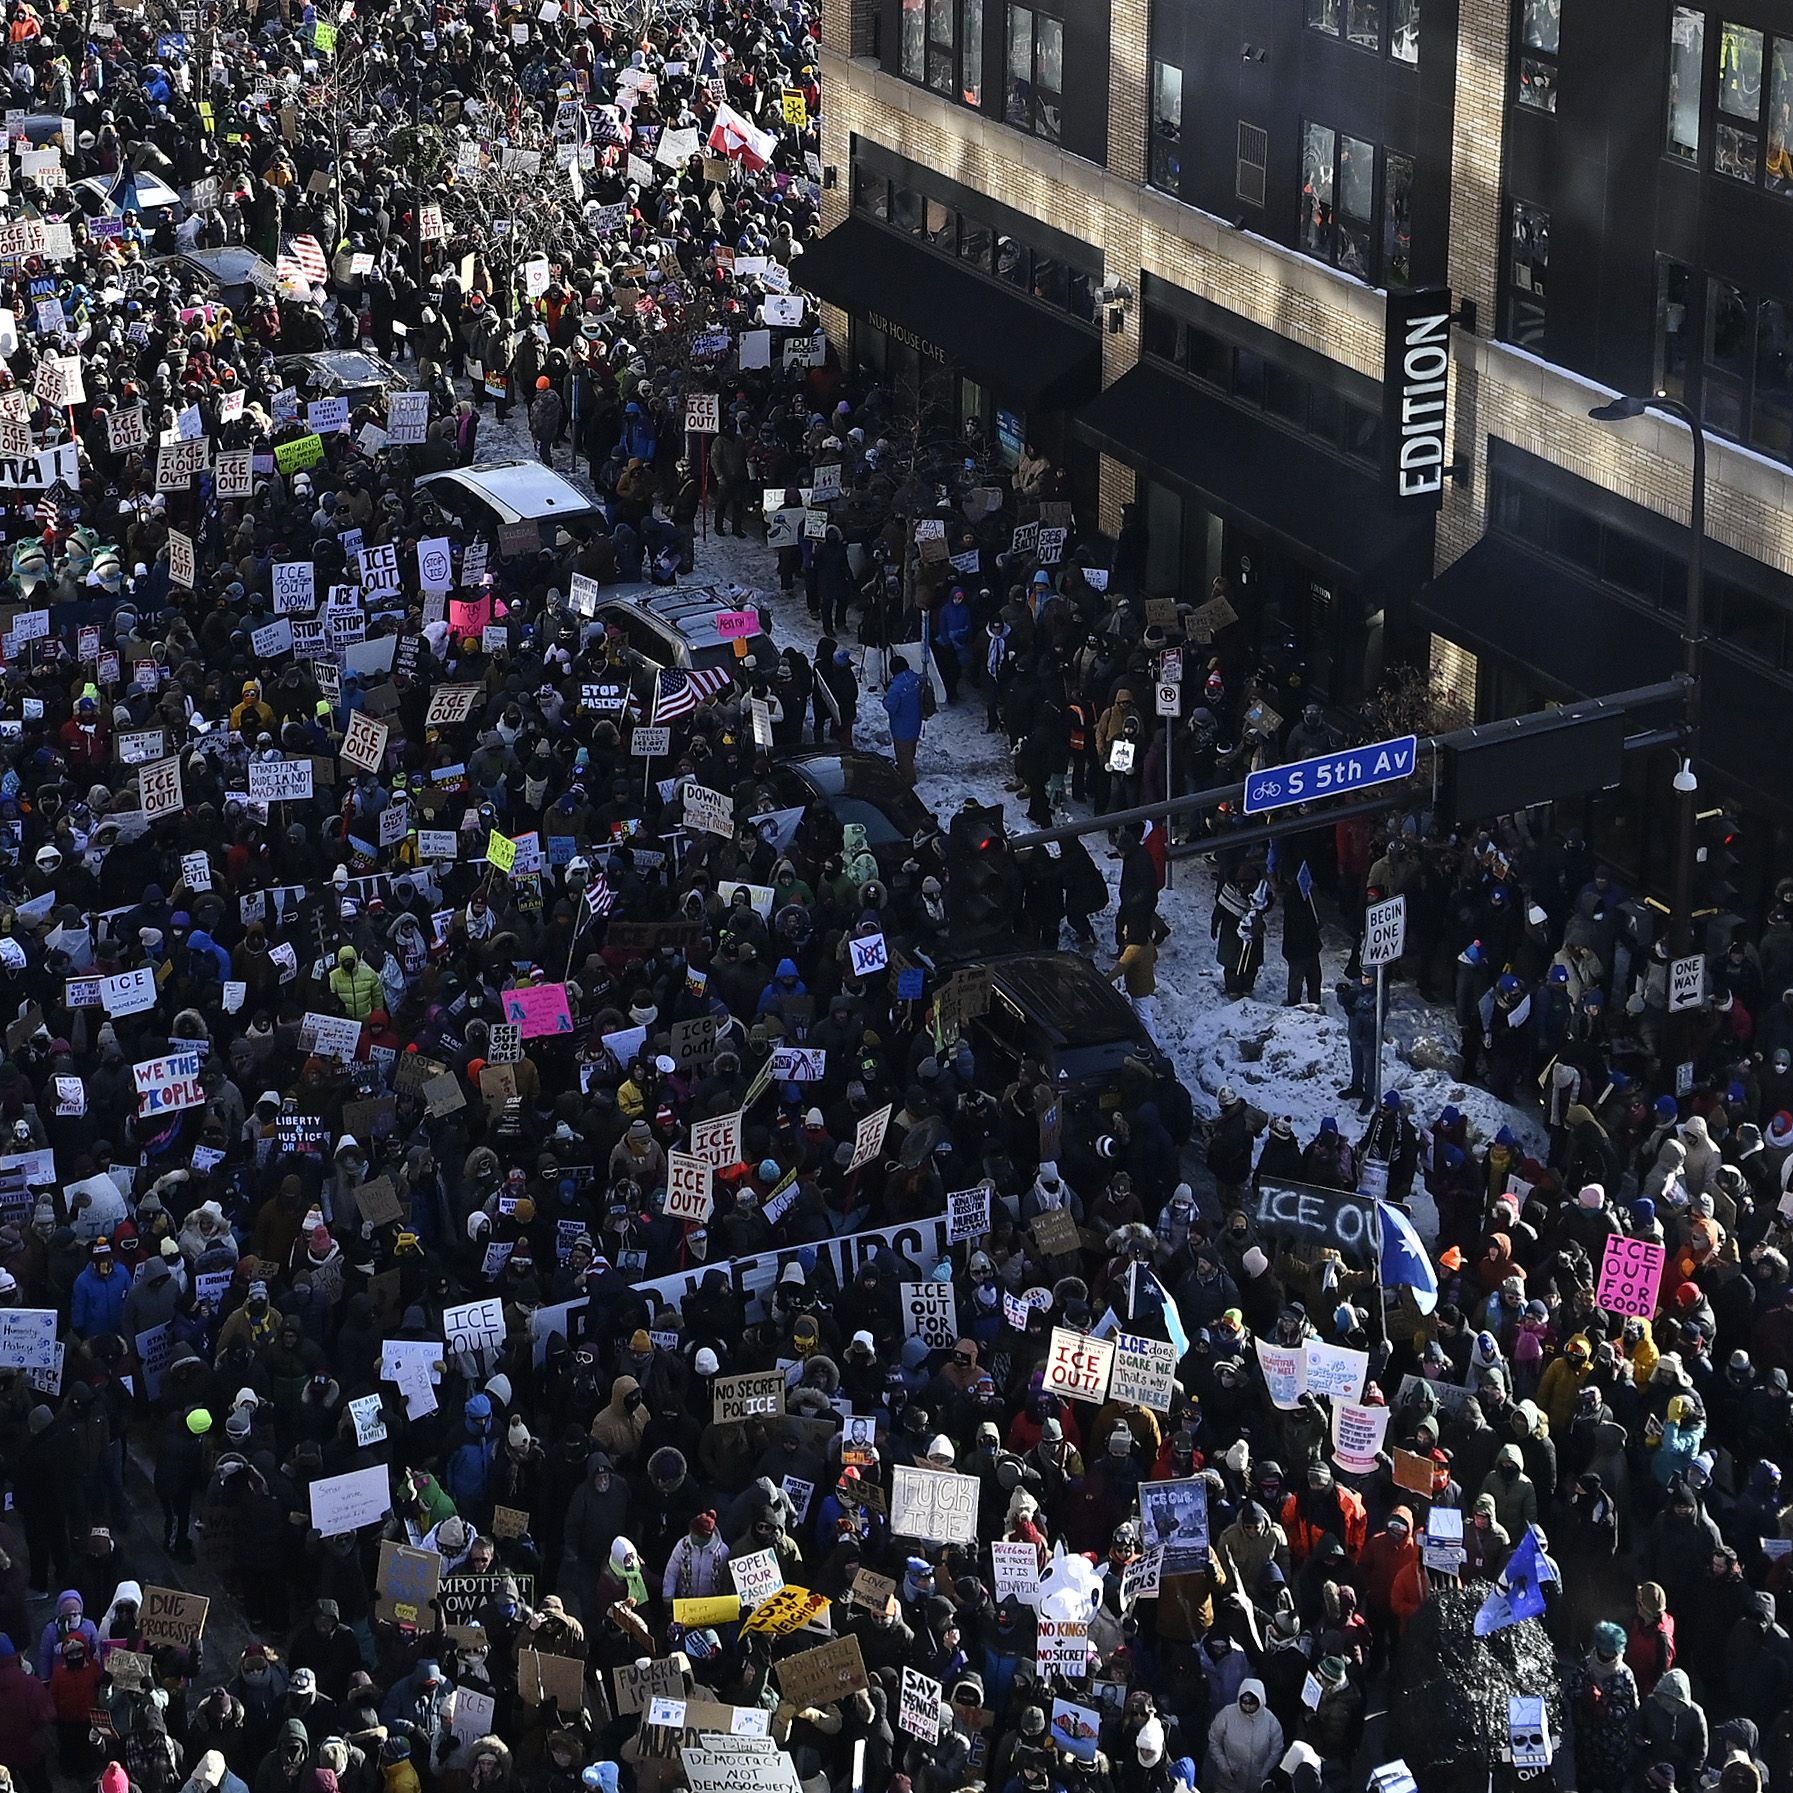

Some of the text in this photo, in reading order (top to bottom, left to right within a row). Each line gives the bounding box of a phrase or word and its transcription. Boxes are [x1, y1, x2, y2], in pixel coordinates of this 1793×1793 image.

[194, 179, 215, 196] NO
[193, 194, 218, 209] ICE
[30, 279, 56, 296] MN
[868, 311, 945, 365] NUR HOUSE CAFE
[688, 401, 714, 415] ICE
[1400, 313, 1449, 497] EDITION
[688, 415, 716, 428] OUT!
[426, 557, 443, 567] STOP
[277, 566, 305, 578] ICE
[429, 569, 442, 578] ICE
[280, 583, 308, 594] OUT
[279, 594, 312, 608] NOW!
[293, 620, 323, 638] STOP
[332, 615, 364, 633] STOP
[316, 667, 337, 686] STOP
[581, 684, 619, 696] STOP
[581, 698, 627, 709] FASCISM
[1288, 750, 1409, 794] S 5th Av
[687, 786, 721, 808] DOWN
[185, 871, 210, 885] EVIL
[1370, 903, 1402, 927] BEGIN
[1373, 923, 1399, 944] ONE
[1369, 942, 1399, 960] WAY
[1676, 960, 1700, 975] ONE
[1675, 974, 1700, 990] WAY
[492, 1027, 518, 1035] ICE
[492, 1034, 517, 1044] OUT
[500, 1042, 516, 1051] OF
[490, 1051, 517, 1061] MPLS
[135, 1055, 199, 1083] WE THE
[696, 1127, 734, 1152] ICE
[672, 1168, 706, 1195] ICE
[669, 1191, 708, 1218] OUT!
[1607, 1236, 1658, 1264] ICE
[1606, 1259, 1658, 1285] OUT
[910, 1283, 949, 1298] ICE
[1604, 1279, 1650, 1302] FOR
[910, 1299, 951, 1316] OUT
[1598, 1294, 1651, 1318] GOOD
[447, 1303, 498, 1333] ICE
[915, 1317, 953, 1334] FOR
[451, 1328, 500, 1353] OUT
[911, 1332, 955, 1348] OOD
[1118, 1334, 1148, 1356] ICE
[1056, 1347, 1101, 1375] ICE
[1119, 1356, 1171, 1375] SCARE ME
[1052, 1364, 1101, 1392] OUT!
[1149, 1376, 1168, 1392] why
[715, 1377, 785, 1400] NO SECRET
[1138, 1387, 1170, 1406] HERE
[722, 1396, 777, 1419] POLICE
[358, 1427, 385, 1443] FAMILY
[903, 1471, 974, 1512] FUCK
[904, 1510, 969, 1543] ICE
[993, 1545, 1033, 1556] Without
[735, 1553, 769, 1573] OPE!
[1001, 1567, 1029, 1577] IT IS
[1124, 1560, 1159, 1579] OUT OF
[739, 1570, 773, 1586] YOUR
[1123, 1571, 1157, 1597] MPLS
[739, 1580, 784, 1601] FASCISM
[996, 1581, 1040, 1594] KIDNAPPING
[756, 1590, 798, 1628] LOVE
[1038, 1621, 1088, 1637] NO KINGS
[1038, 1648, 1085, 1662] NO SECRET
[1043, 1663, 1082, 1678] POLICE
[904, 1669, 939, 1698] SAY
[900, 1719, 938, 1744] BITCHES
[689, 1753, 782, 1768] DEMOCRACY
[725, 1767, 758, 1781] NOT
[691, 1778, 799, 1793] DEMAGOGUERY!
